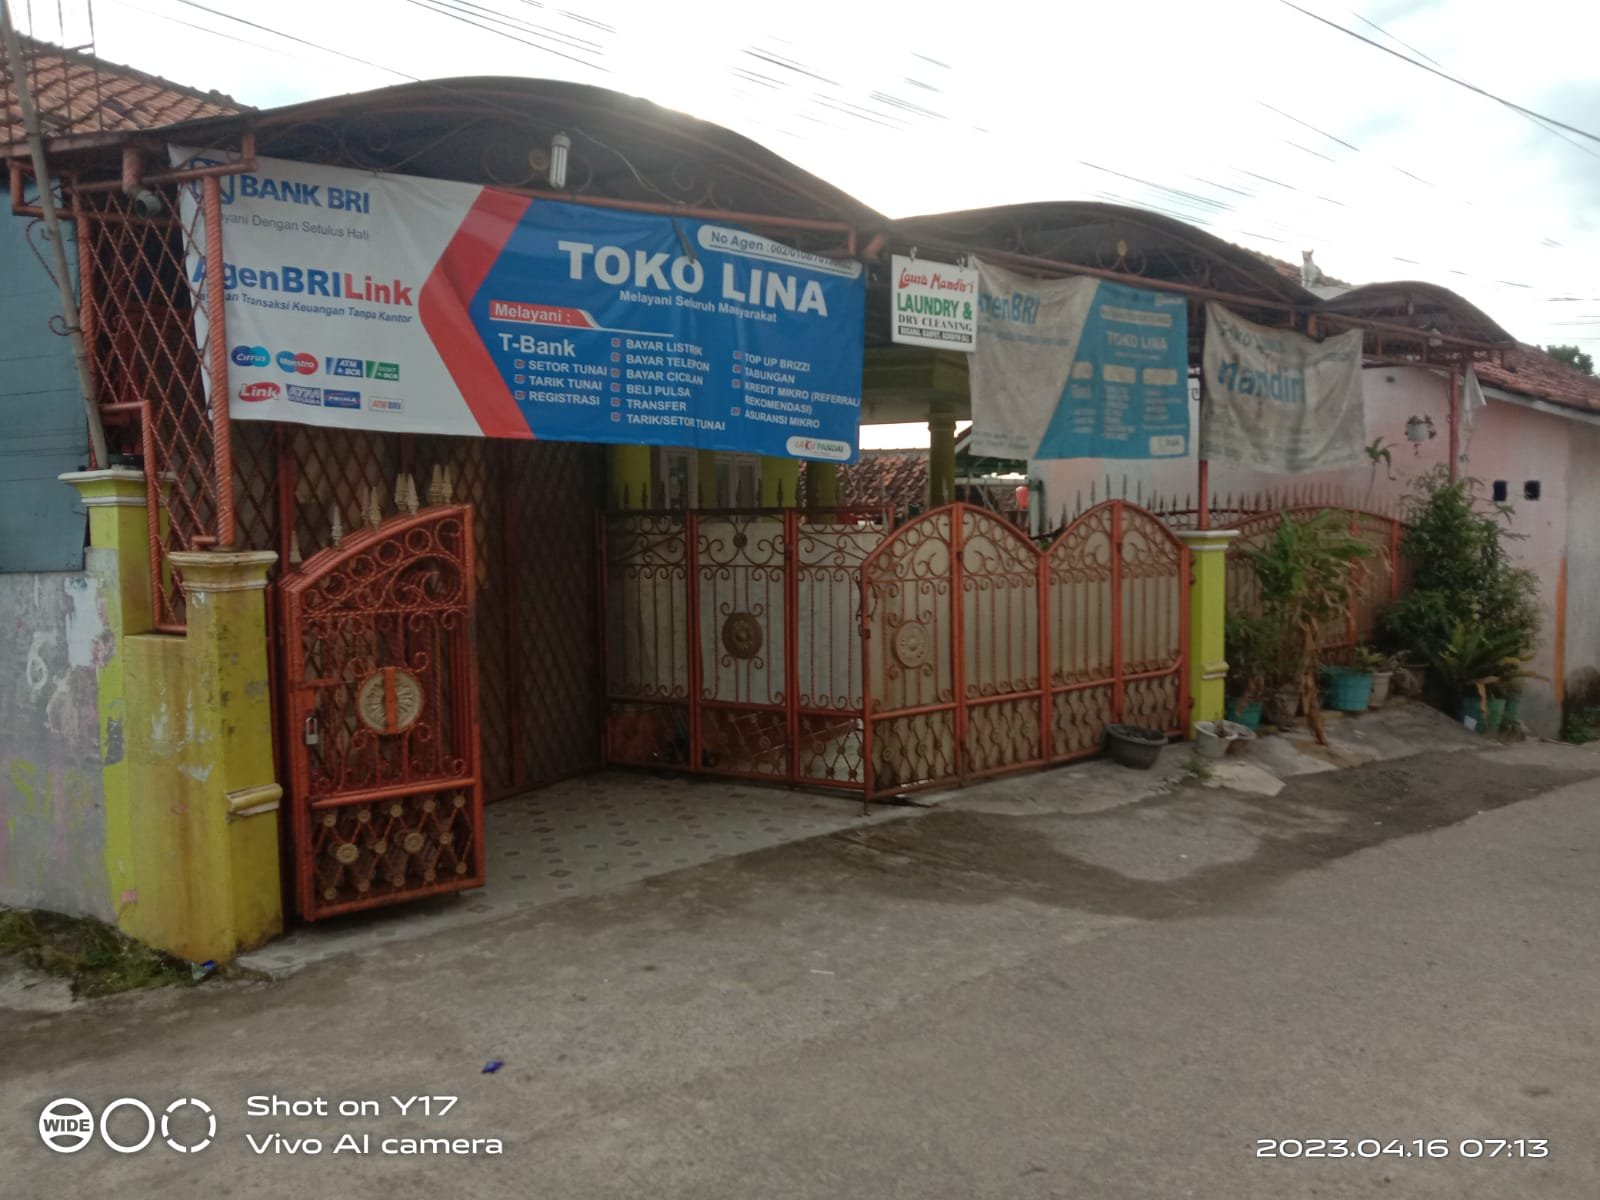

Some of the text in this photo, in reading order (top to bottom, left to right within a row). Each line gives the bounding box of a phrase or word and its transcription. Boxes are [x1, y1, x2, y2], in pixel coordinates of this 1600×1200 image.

[240, 175, 370, 214] BANK BRI
[252, 215, 299, 232] Dengan
[302, 221, 344, 237] Setulus
[347, 229, 369, 240] Hati
[711, 231, 728, 244] No
[731, 235, 763, 250] Agen
[558, 240, 828, 317] TOKO LINA
[242, 293, 289, 310] Transaksi
[292, 301, 345, 316] Keuangan
[348, 306, 376, 320] Tanpa
[378, 311, 412, 323] Kantor
[495, 303, 562, 323] Melayani
[620, 290, 777, 323] Melayani Seluruh Masyarakat
[897, 292, 973, 320] LAUNDRY &
[898, 314, 973, 332] DRY CLEANING
[498, 332, 576, 358] T-Bank
[626, 339, 664, 352] BAYAR
[1107, 331, 1137, 348] TOKO
[236, 352, 267, 362] Cirrus
[626, 354, 664, 367] BAYAR
[744, 353, 761, 363] TOP
[763, 357, 778, 367] UP
[528, 360, 608, 376] SETOR TUNAI
[626, 369, 664, 382] BAYAR
[744, 367, 795, 384] TABUNGAN
[240, 384, 279, 399] Link
[528, 376, 602, 391] TARIK TUNAI
[626, 384, 691, 398] BELI PULSA
[744, 381, 775, 395] KREDIT
[777, 387, 809, 399] MIKRO
[528, 391, 600, 405] REGISTRASI
[626, 399, 687, 411] TRANSFER
[696, 418, 725, 431] TUNAI
[744, 409, 820, 429] ASURANSI MIKRO
